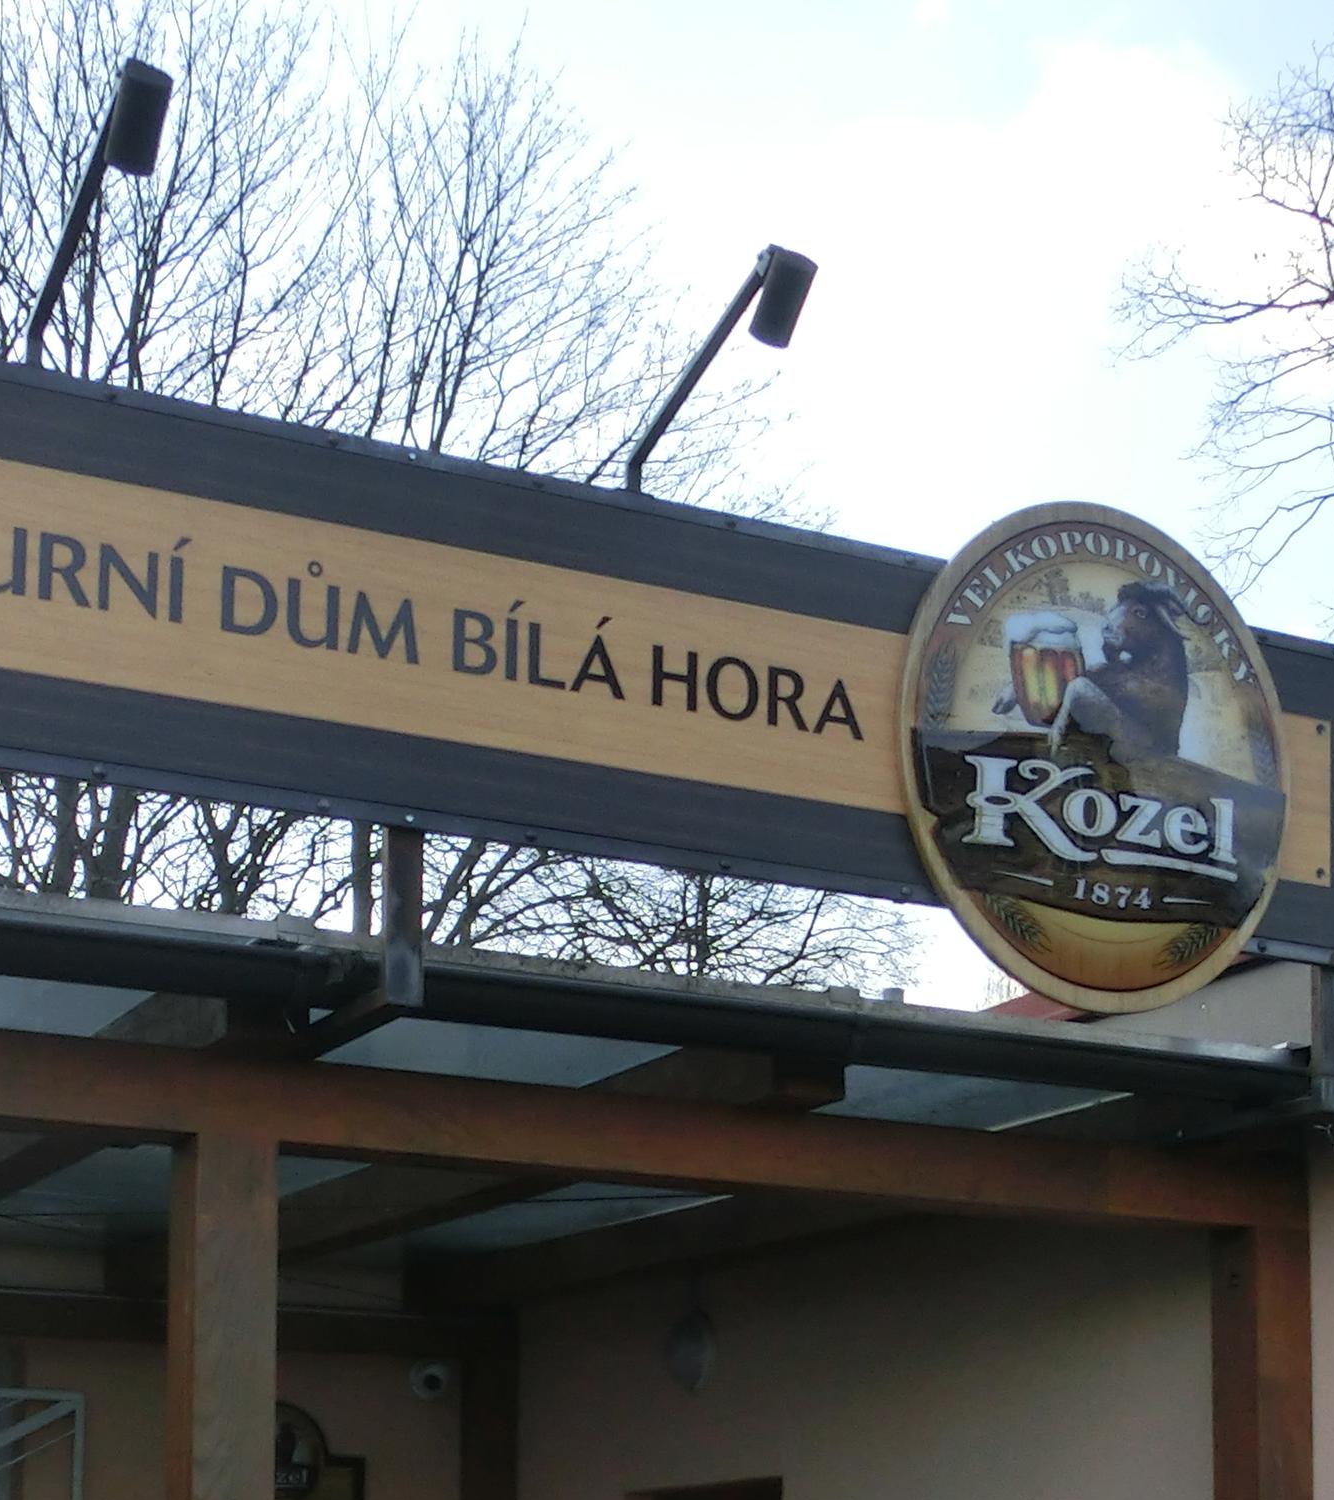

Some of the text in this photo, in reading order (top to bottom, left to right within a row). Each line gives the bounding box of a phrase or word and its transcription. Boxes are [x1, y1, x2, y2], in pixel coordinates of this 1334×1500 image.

[218, 559, 420, 667] DŮM
[451, 600, 626, 701] BÍLÁ
[650, 641, 865, 743] HORA
[961, 752, 1240, 872] Kozel
[1073, 877, 1153, 910] 1874
[275, 1467, 309, 1485] zel
